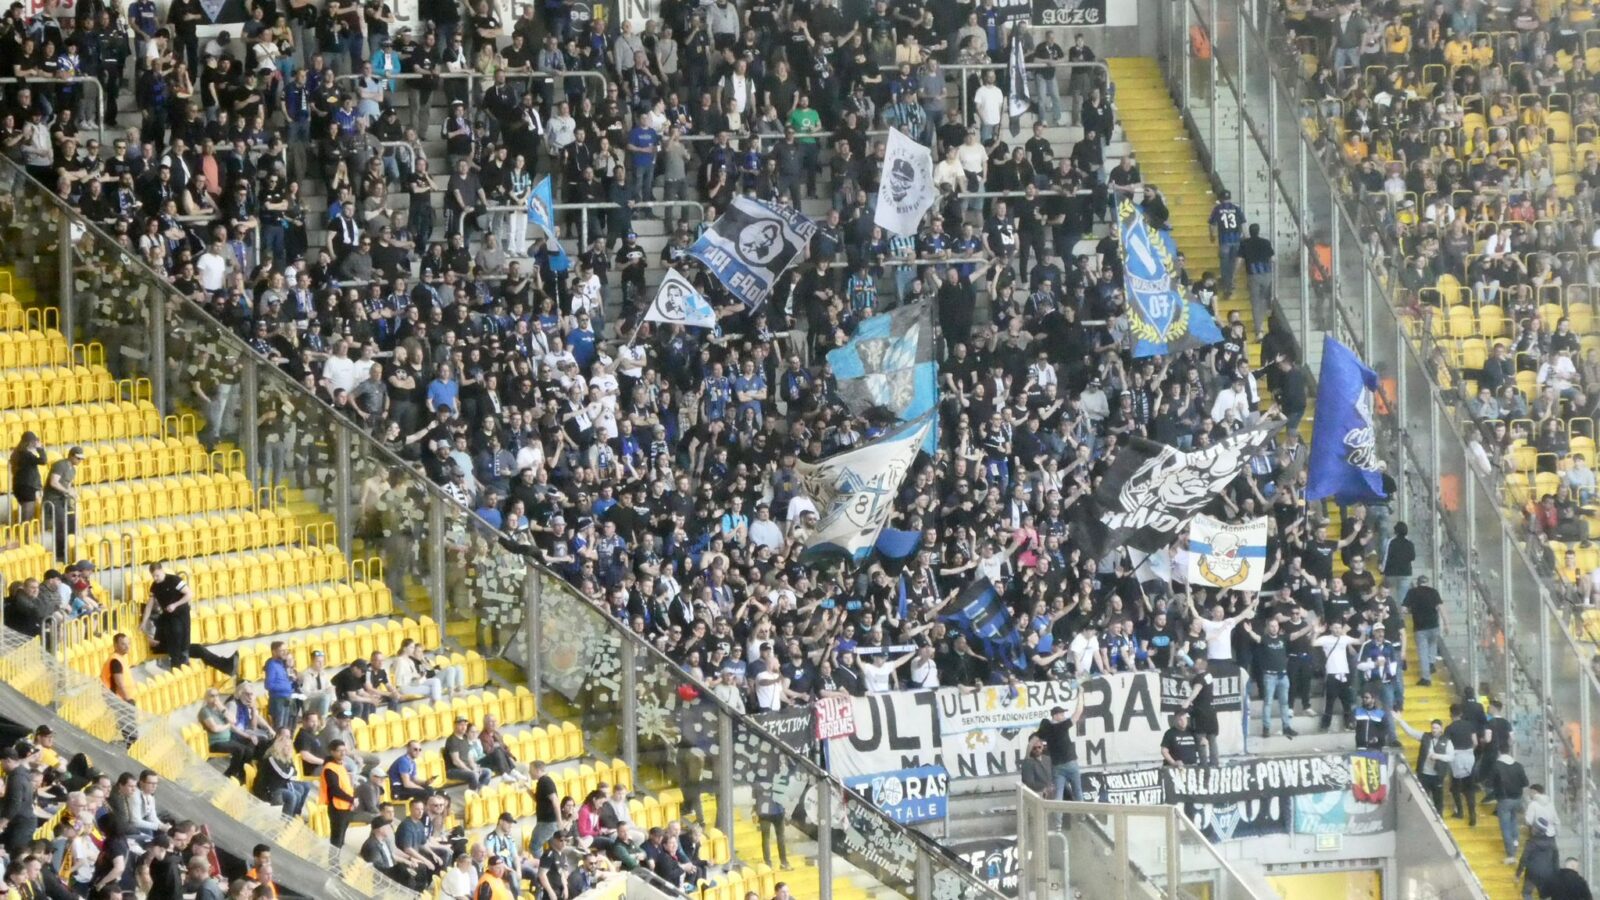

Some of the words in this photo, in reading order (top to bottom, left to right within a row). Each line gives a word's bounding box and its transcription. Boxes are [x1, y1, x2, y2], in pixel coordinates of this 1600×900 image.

[1042, 8, 1099, 24] ATZE
[1221, 213, 1237, 228] 13
[1149, 295, 1169, 318] 07
